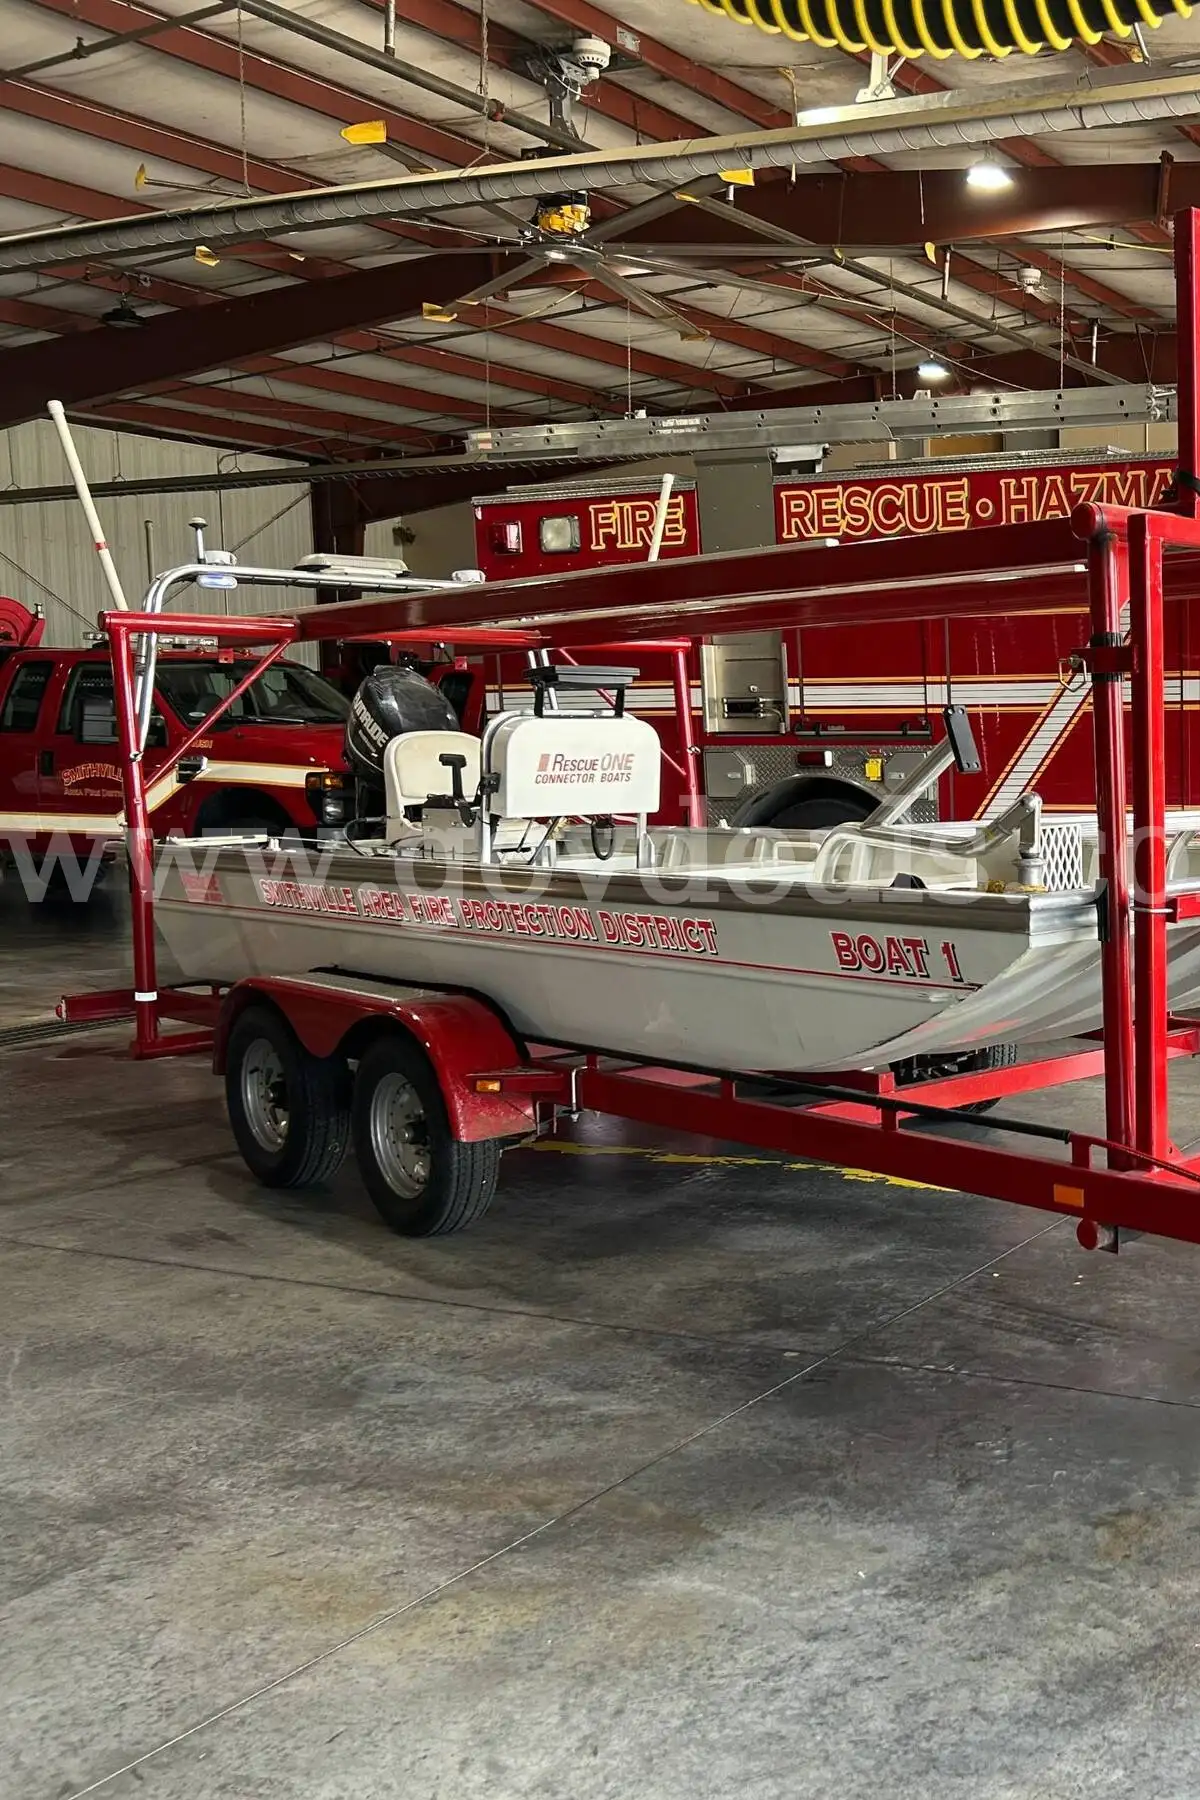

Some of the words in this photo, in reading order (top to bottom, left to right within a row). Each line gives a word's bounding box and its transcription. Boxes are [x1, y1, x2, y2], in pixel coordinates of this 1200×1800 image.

[588, 495, 687, 550] FIRE
[781, 478, 971, 539] RESCUE
[1000, 468, 1173, 525] HAZMA
[62, 763, 124, 786] SMITHVILL
[535, 773, 595, 785] CONNECTOR
[600, 772, 631, 783] BOATS
[259, 879, 359, 916] SMITHVILLE
[357, 888, 410, 922] AREA
[406, 893, 459, 928] FIRE
[456, 897, 598, 942] PROTECTION
[597, 909, 719, 955] DISTRICT
[829, 931, 930, 979] BOAT
[940, 940, 964, 982] 1
